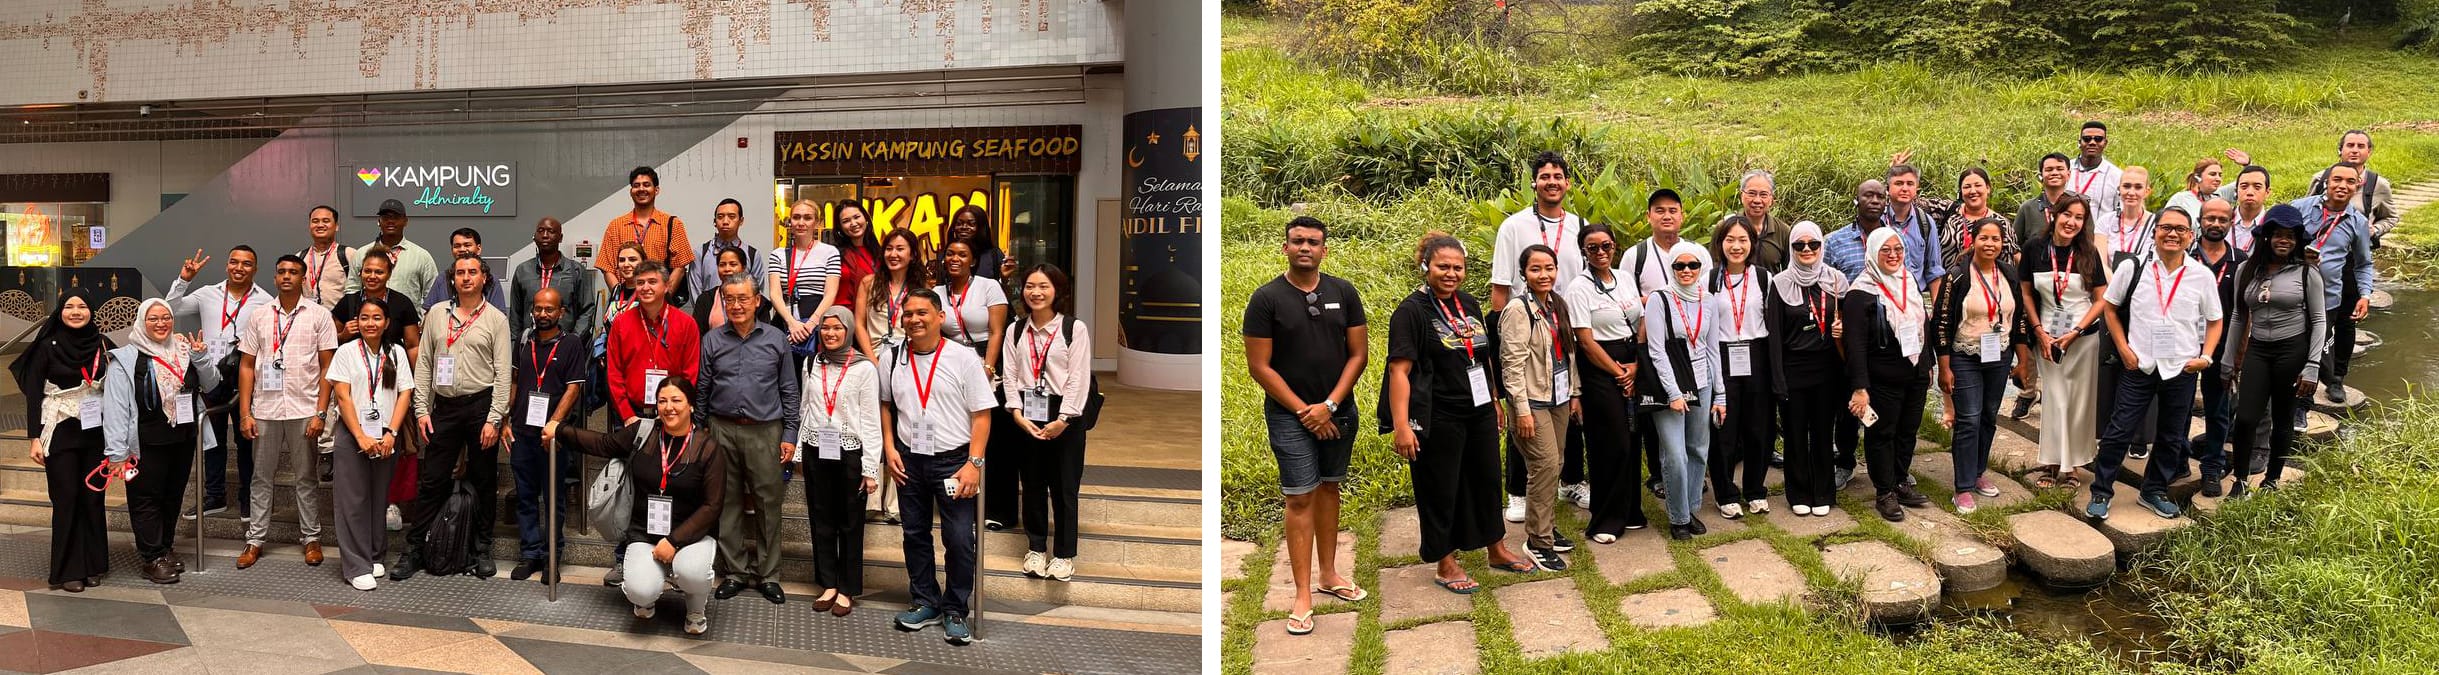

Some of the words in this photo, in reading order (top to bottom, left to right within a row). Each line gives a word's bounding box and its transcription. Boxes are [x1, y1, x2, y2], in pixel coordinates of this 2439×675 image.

[781, 142, 853, 161] YASSIN
[861, 140, 966, 161] KAMPUNG
[972, 137, 1079, 159] SEAFOOD
[384, 164, 510, 188] KAMPUNG
[413, 185, 495, 213] Admiralty
[1129, 195, 1171, 214] Hari
